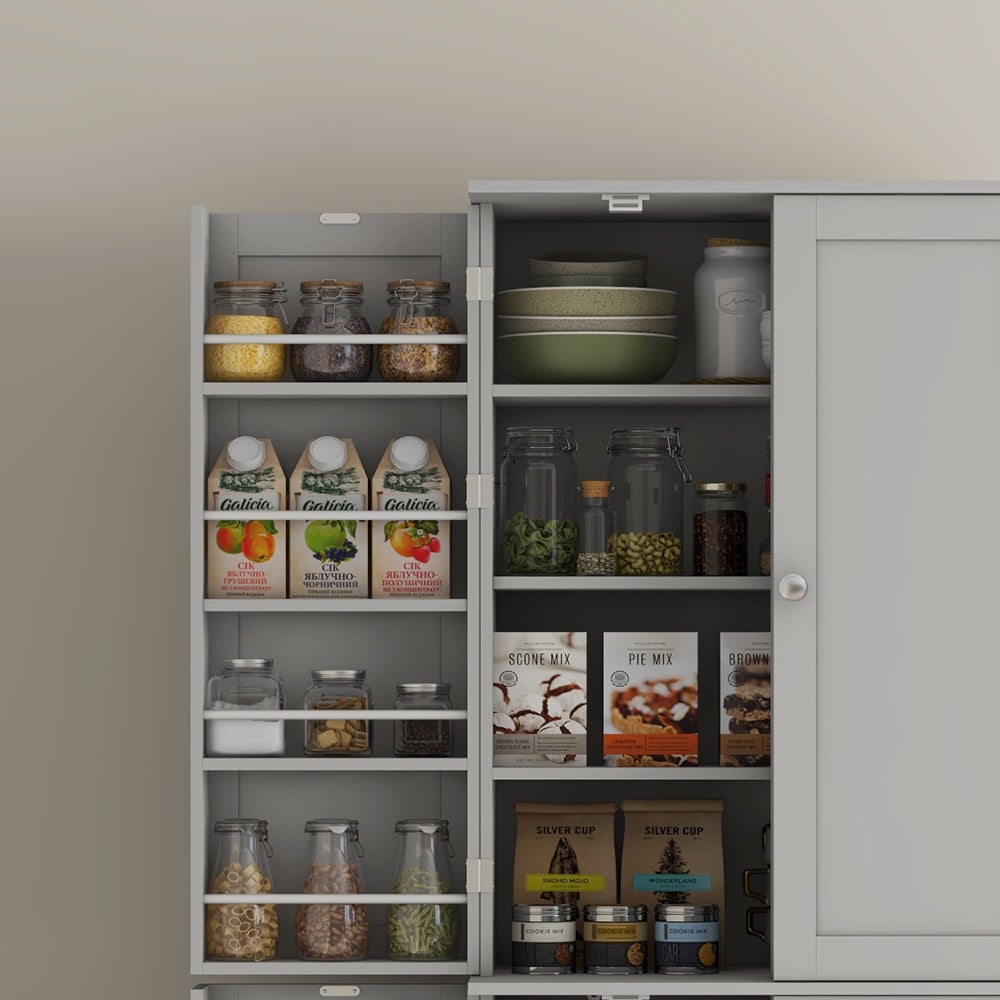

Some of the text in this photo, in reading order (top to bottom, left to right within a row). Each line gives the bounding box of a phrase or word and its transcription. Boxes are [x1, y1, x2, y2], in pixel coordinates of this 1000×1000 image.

[220, 497, 275, 511] Galicia
[384, 497, 440, 511] Galicia
[237, 562, 254, 570] СІК
[321, 564, 339, 572] СІК
[403, 562, 421, 570] СІК
[304, 572, 357, 581] ЯБЛУЧНО-
[385, 571, 438, 579] ЯБЛУЧНО-
[303, 580, 359, 588] ЧОРНИЧНИЙ
[508, 652, 571, 666] SCONE MIX
[629, 652, 673, 666] PIE MIX
[728, 652, 770, 667] BROWN
[536, 826, 596, 835] SILVER CUP
[644, 826, 704, 836] SILVER CUP
[649, 877, 697, 885] WONDERLAND
